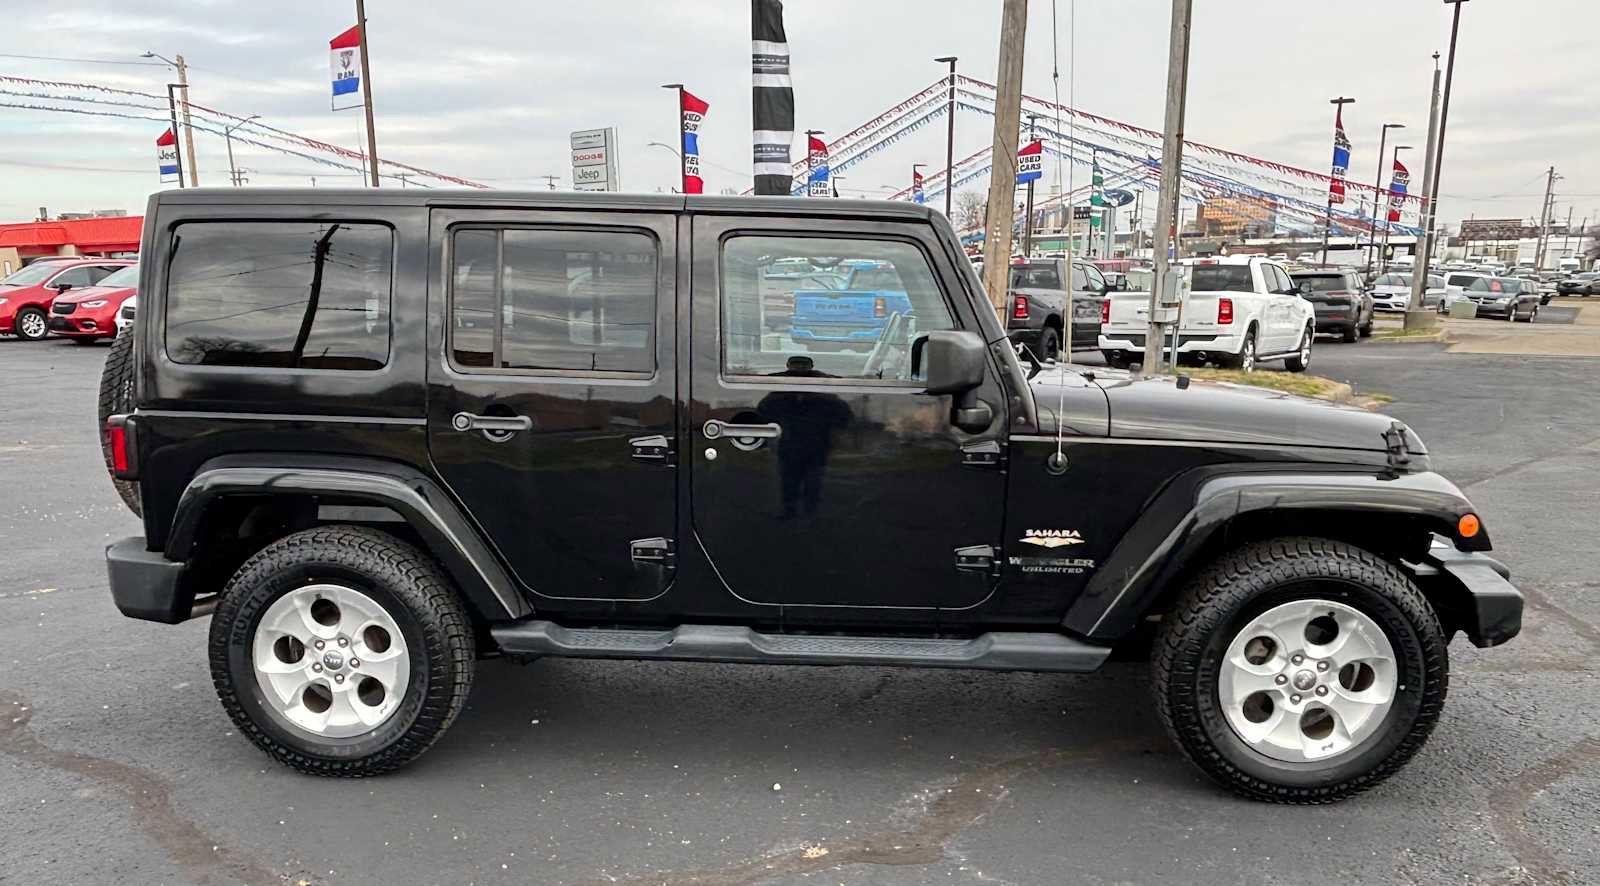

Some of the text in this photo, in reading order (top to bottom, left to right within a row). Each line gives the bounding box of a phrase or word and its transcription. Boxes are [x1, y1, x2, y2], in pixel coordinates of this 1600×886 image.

[573, 153, 604, 162] DODGE
[1019, 155, 1042, 164] USED
[1019, 163, 1042, 172] CARS
[577, 167, 601, 181] Jeep
[1025, 528, 1081, 538] SAHARA
